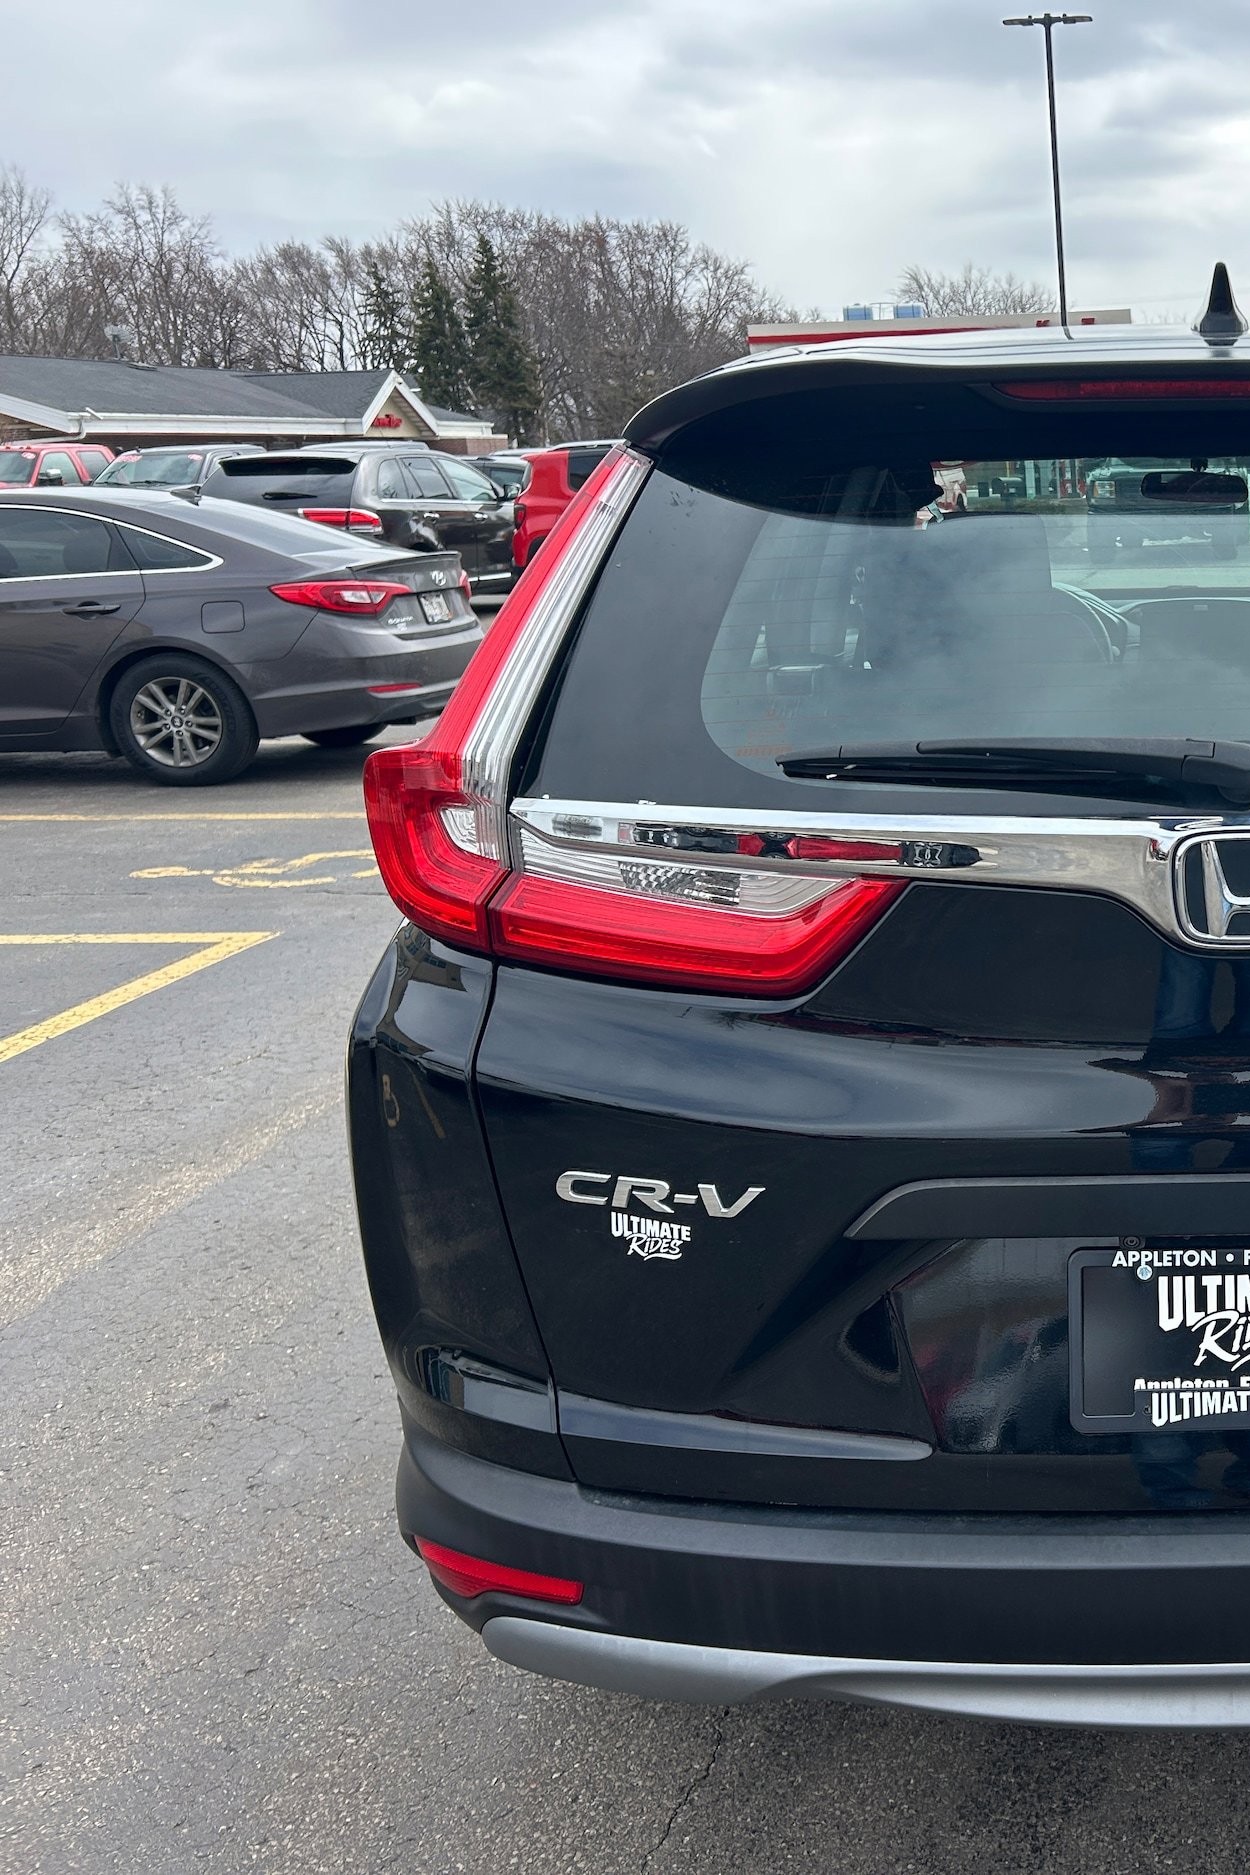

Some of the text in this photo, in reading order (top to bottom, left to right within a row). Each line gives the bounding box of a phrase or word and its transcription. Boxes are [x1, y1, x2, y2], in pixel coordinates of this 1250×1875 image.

[555, 1170, 766, 1219] CR-V
[610, 1211, 692, 1242] ULTIMATE
[1111, 1249, 1218, 1268] APPLETON
